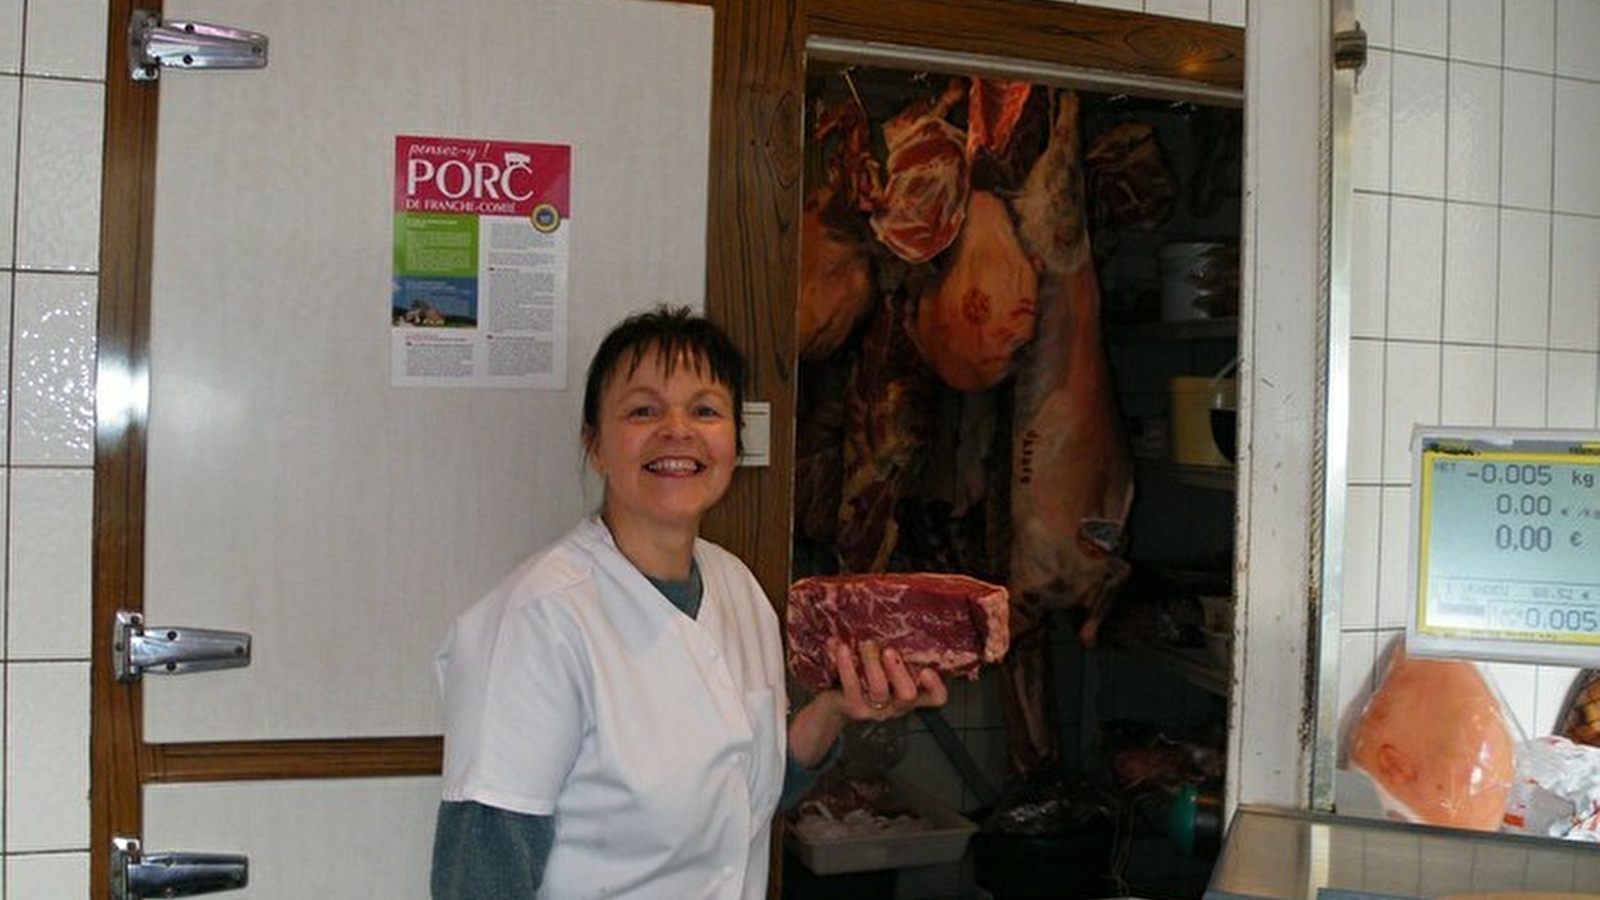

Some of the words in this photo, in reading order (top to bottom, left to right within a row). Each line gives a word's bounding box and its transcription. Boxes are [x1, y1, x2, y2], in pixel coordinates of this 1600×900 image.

[406, 158, 534, 202] PORC
[405, 198, 420, 210] DE
[1466, 463, 1553, 486] -0.005
[1571, 470, 1595, 488] kg
[1496, 493, 1553, 516] 0.00
